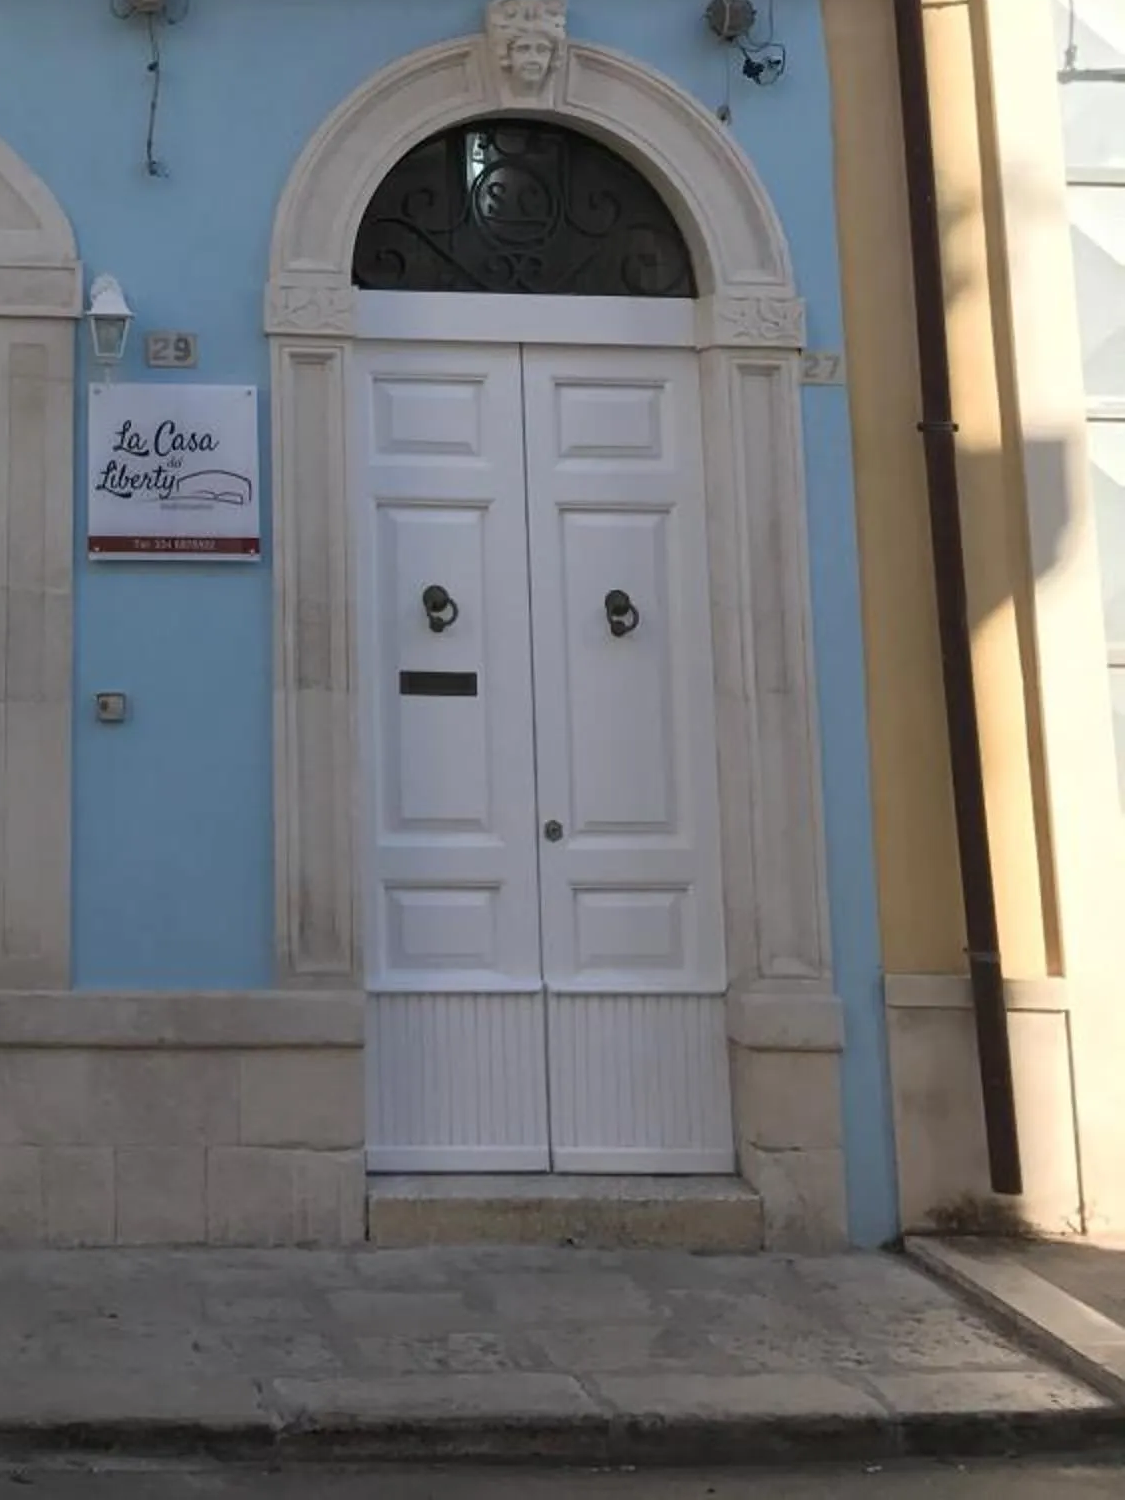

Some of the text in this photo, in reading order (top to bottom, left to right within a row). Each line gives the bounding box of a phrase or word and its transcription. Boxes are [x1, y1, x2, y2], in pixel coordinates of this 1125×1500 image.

[152, 337, 192, 361] 29
[804, 354, 840, 378] 27
[112, 419, 220, 457] La Casa
[95, 459, 176, 500] Liberty
